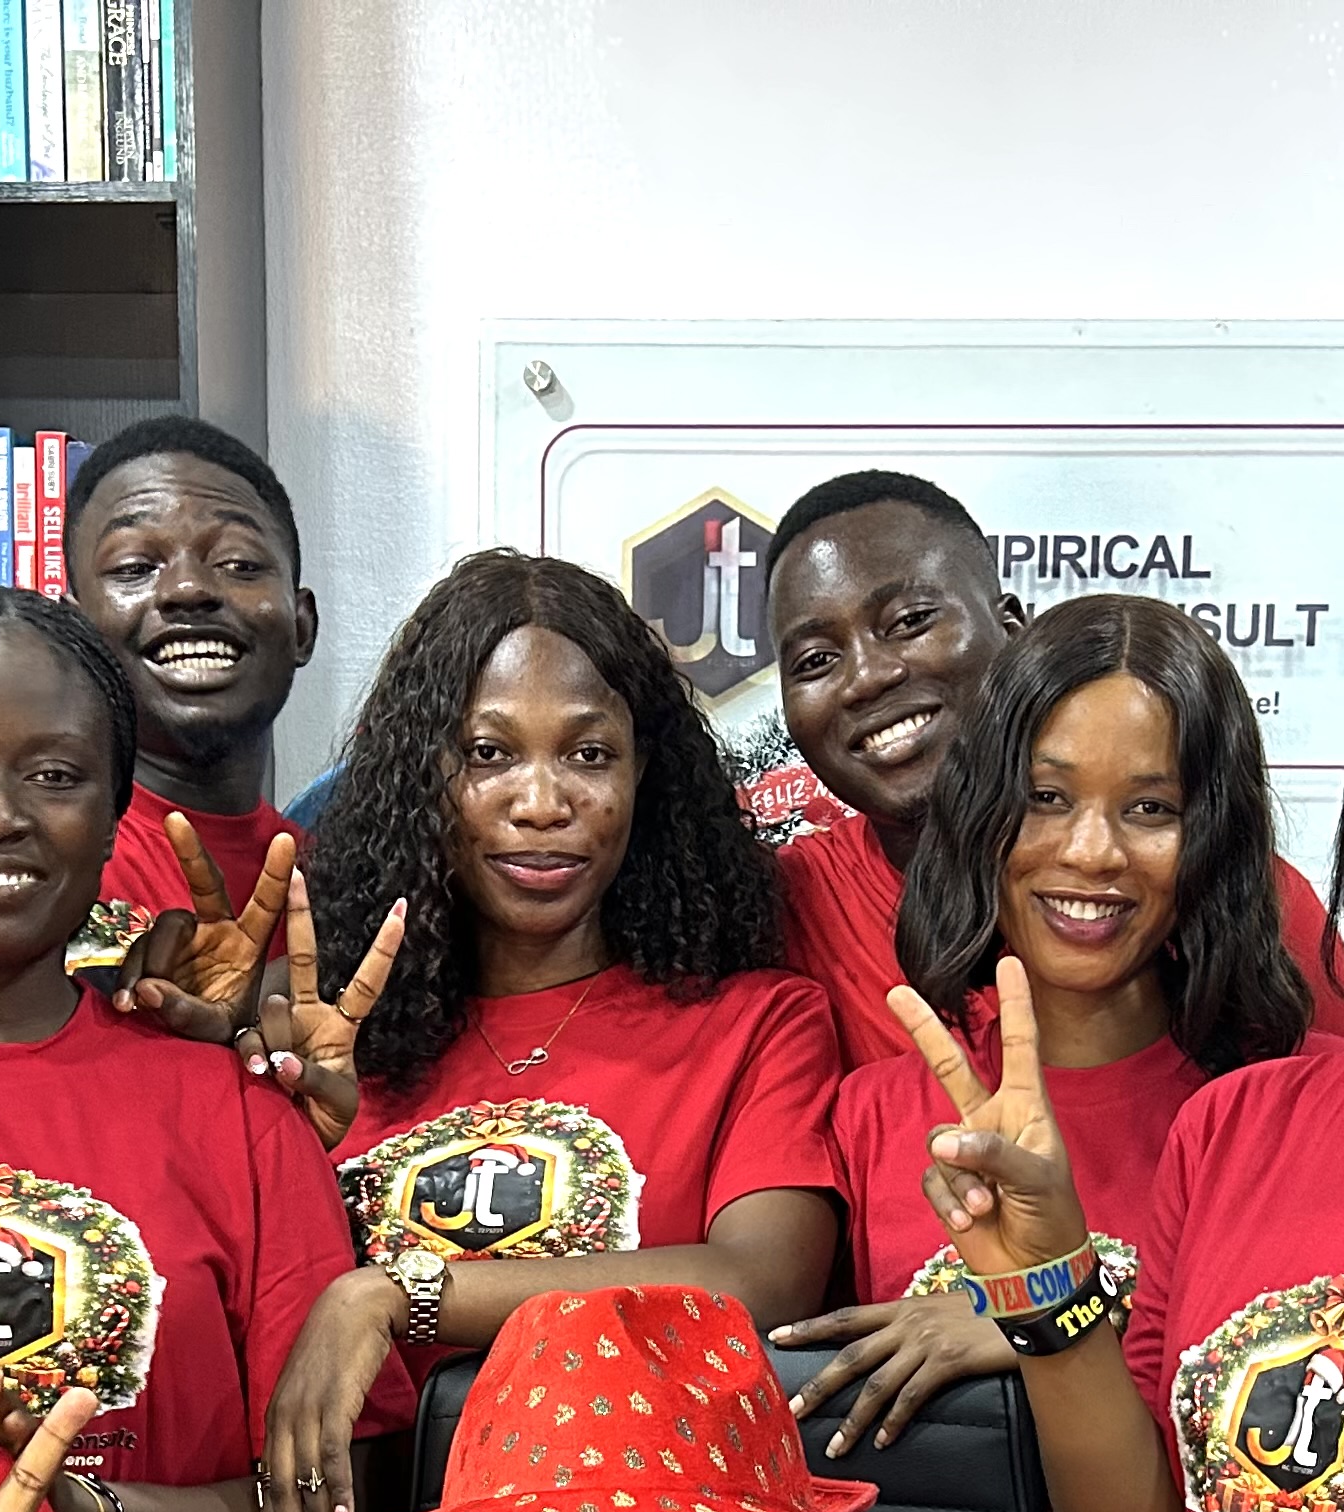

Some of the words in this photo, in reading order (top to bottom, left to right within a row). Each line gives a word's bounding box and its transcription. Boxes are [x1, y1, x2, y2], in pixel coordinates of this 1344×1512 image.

[1, 38, 13, 66] your
[107, 0, 128, 66] GRACE
[114, 111, 125, 164] ENGLUND
[123, 117, 135, 159] STEVEN
[16, 482, 33, 534] brilliant
[42, 506, 61, 542] SELL
[43, 546, 61, 580] LIKE
[985, 534, 1212, 579] PIRICAL
[1178, 603, 1329, 648] SULT
[750, 778, 805, 809] FELIZ
[1056, 1294, 1104, 1338] The
